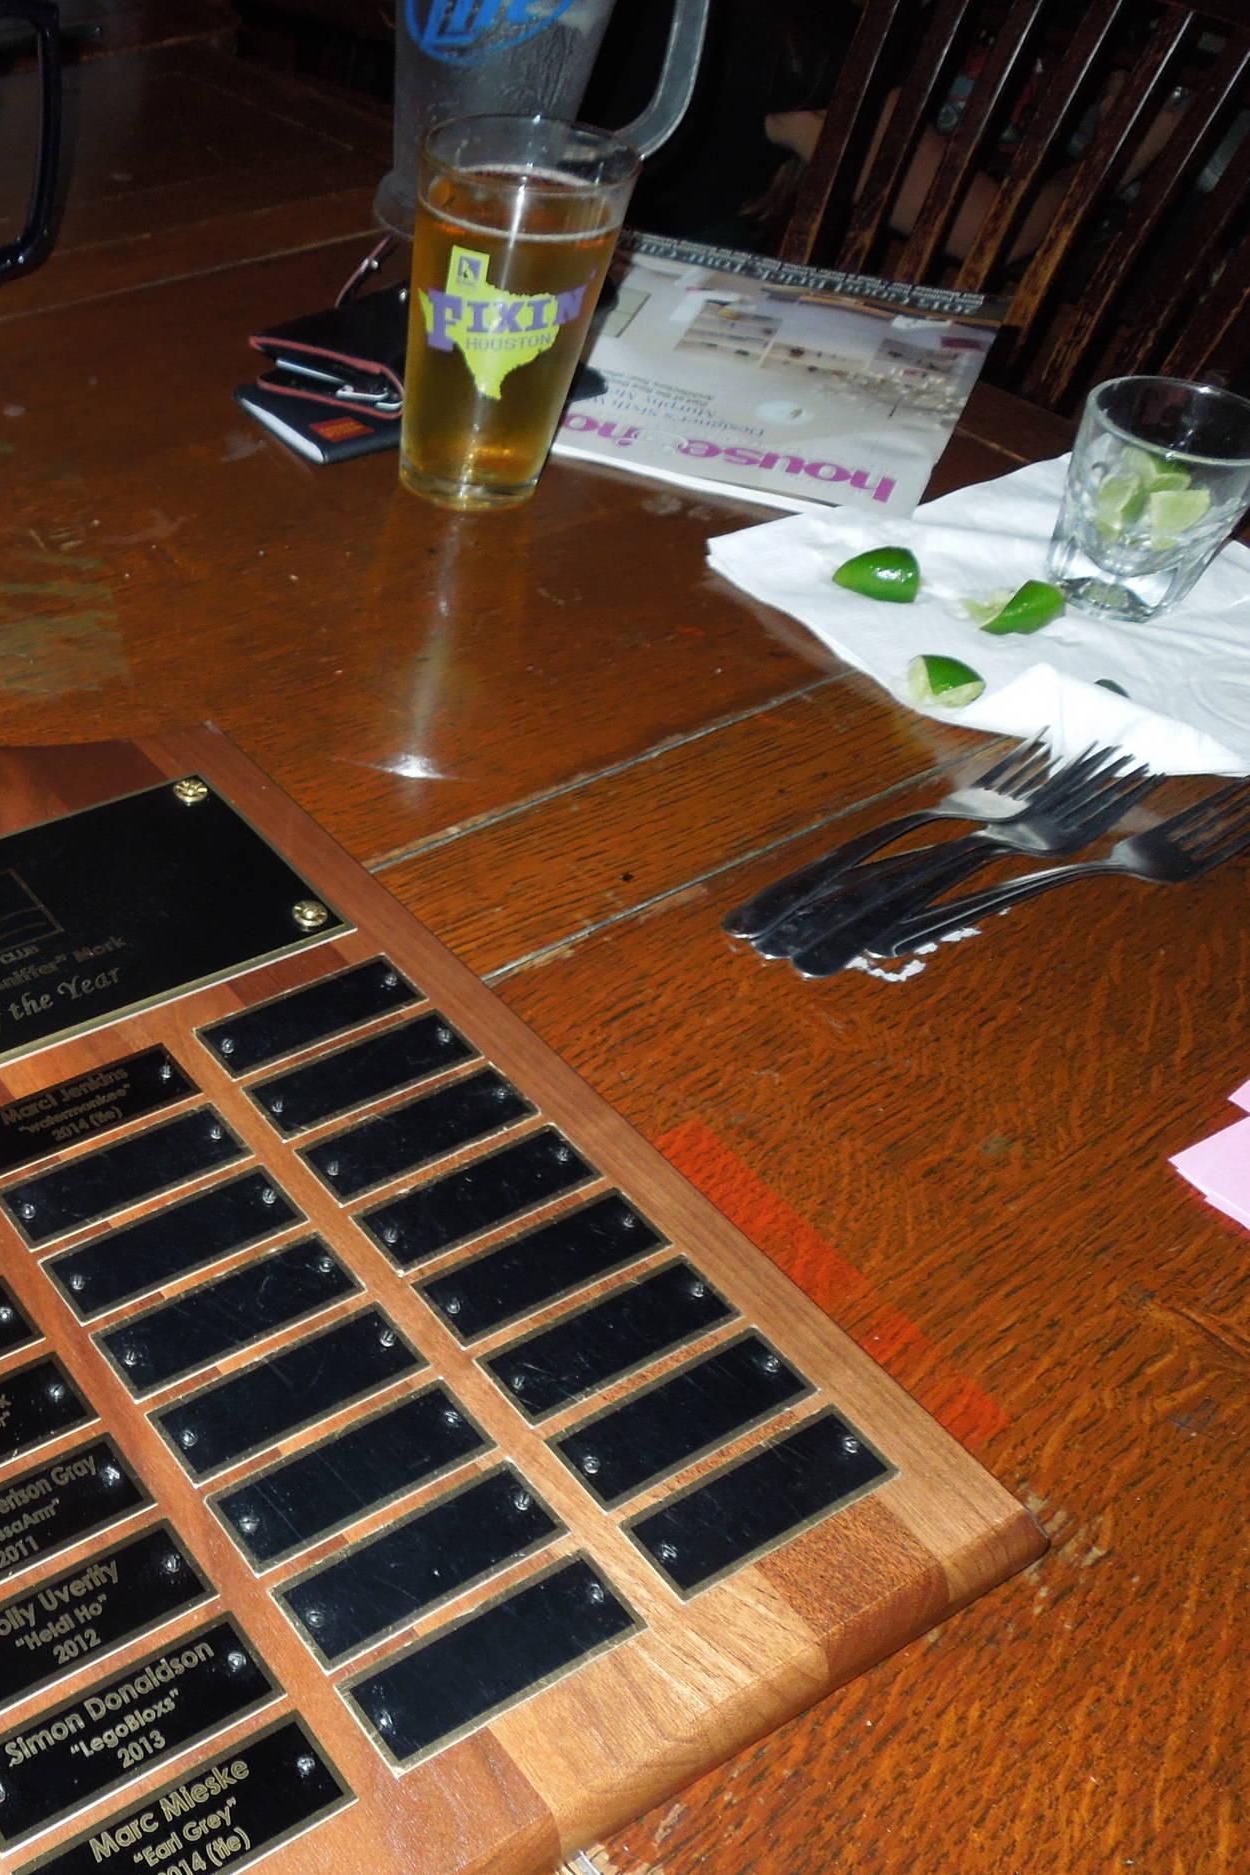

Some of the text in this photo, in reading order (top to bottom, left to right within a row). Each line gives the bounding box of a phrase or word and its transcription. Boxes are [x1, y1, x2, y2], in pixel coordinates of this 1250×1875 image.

[466, 333, 551, 351] HOUSTON
[678, 439, 897, 504] house
[7, 991, 54, 1021] the
[56, 966, 121, 1001] Year
[50, 1455, 97, 1487] Gray
[52, 1628, 102, 1665] 2012
[4, 1641, 216, 1767] Simon Donaldson
[117, 1729, 167, 1769] 2013
[87, 1760, 251, 1864] Marc Mieske
